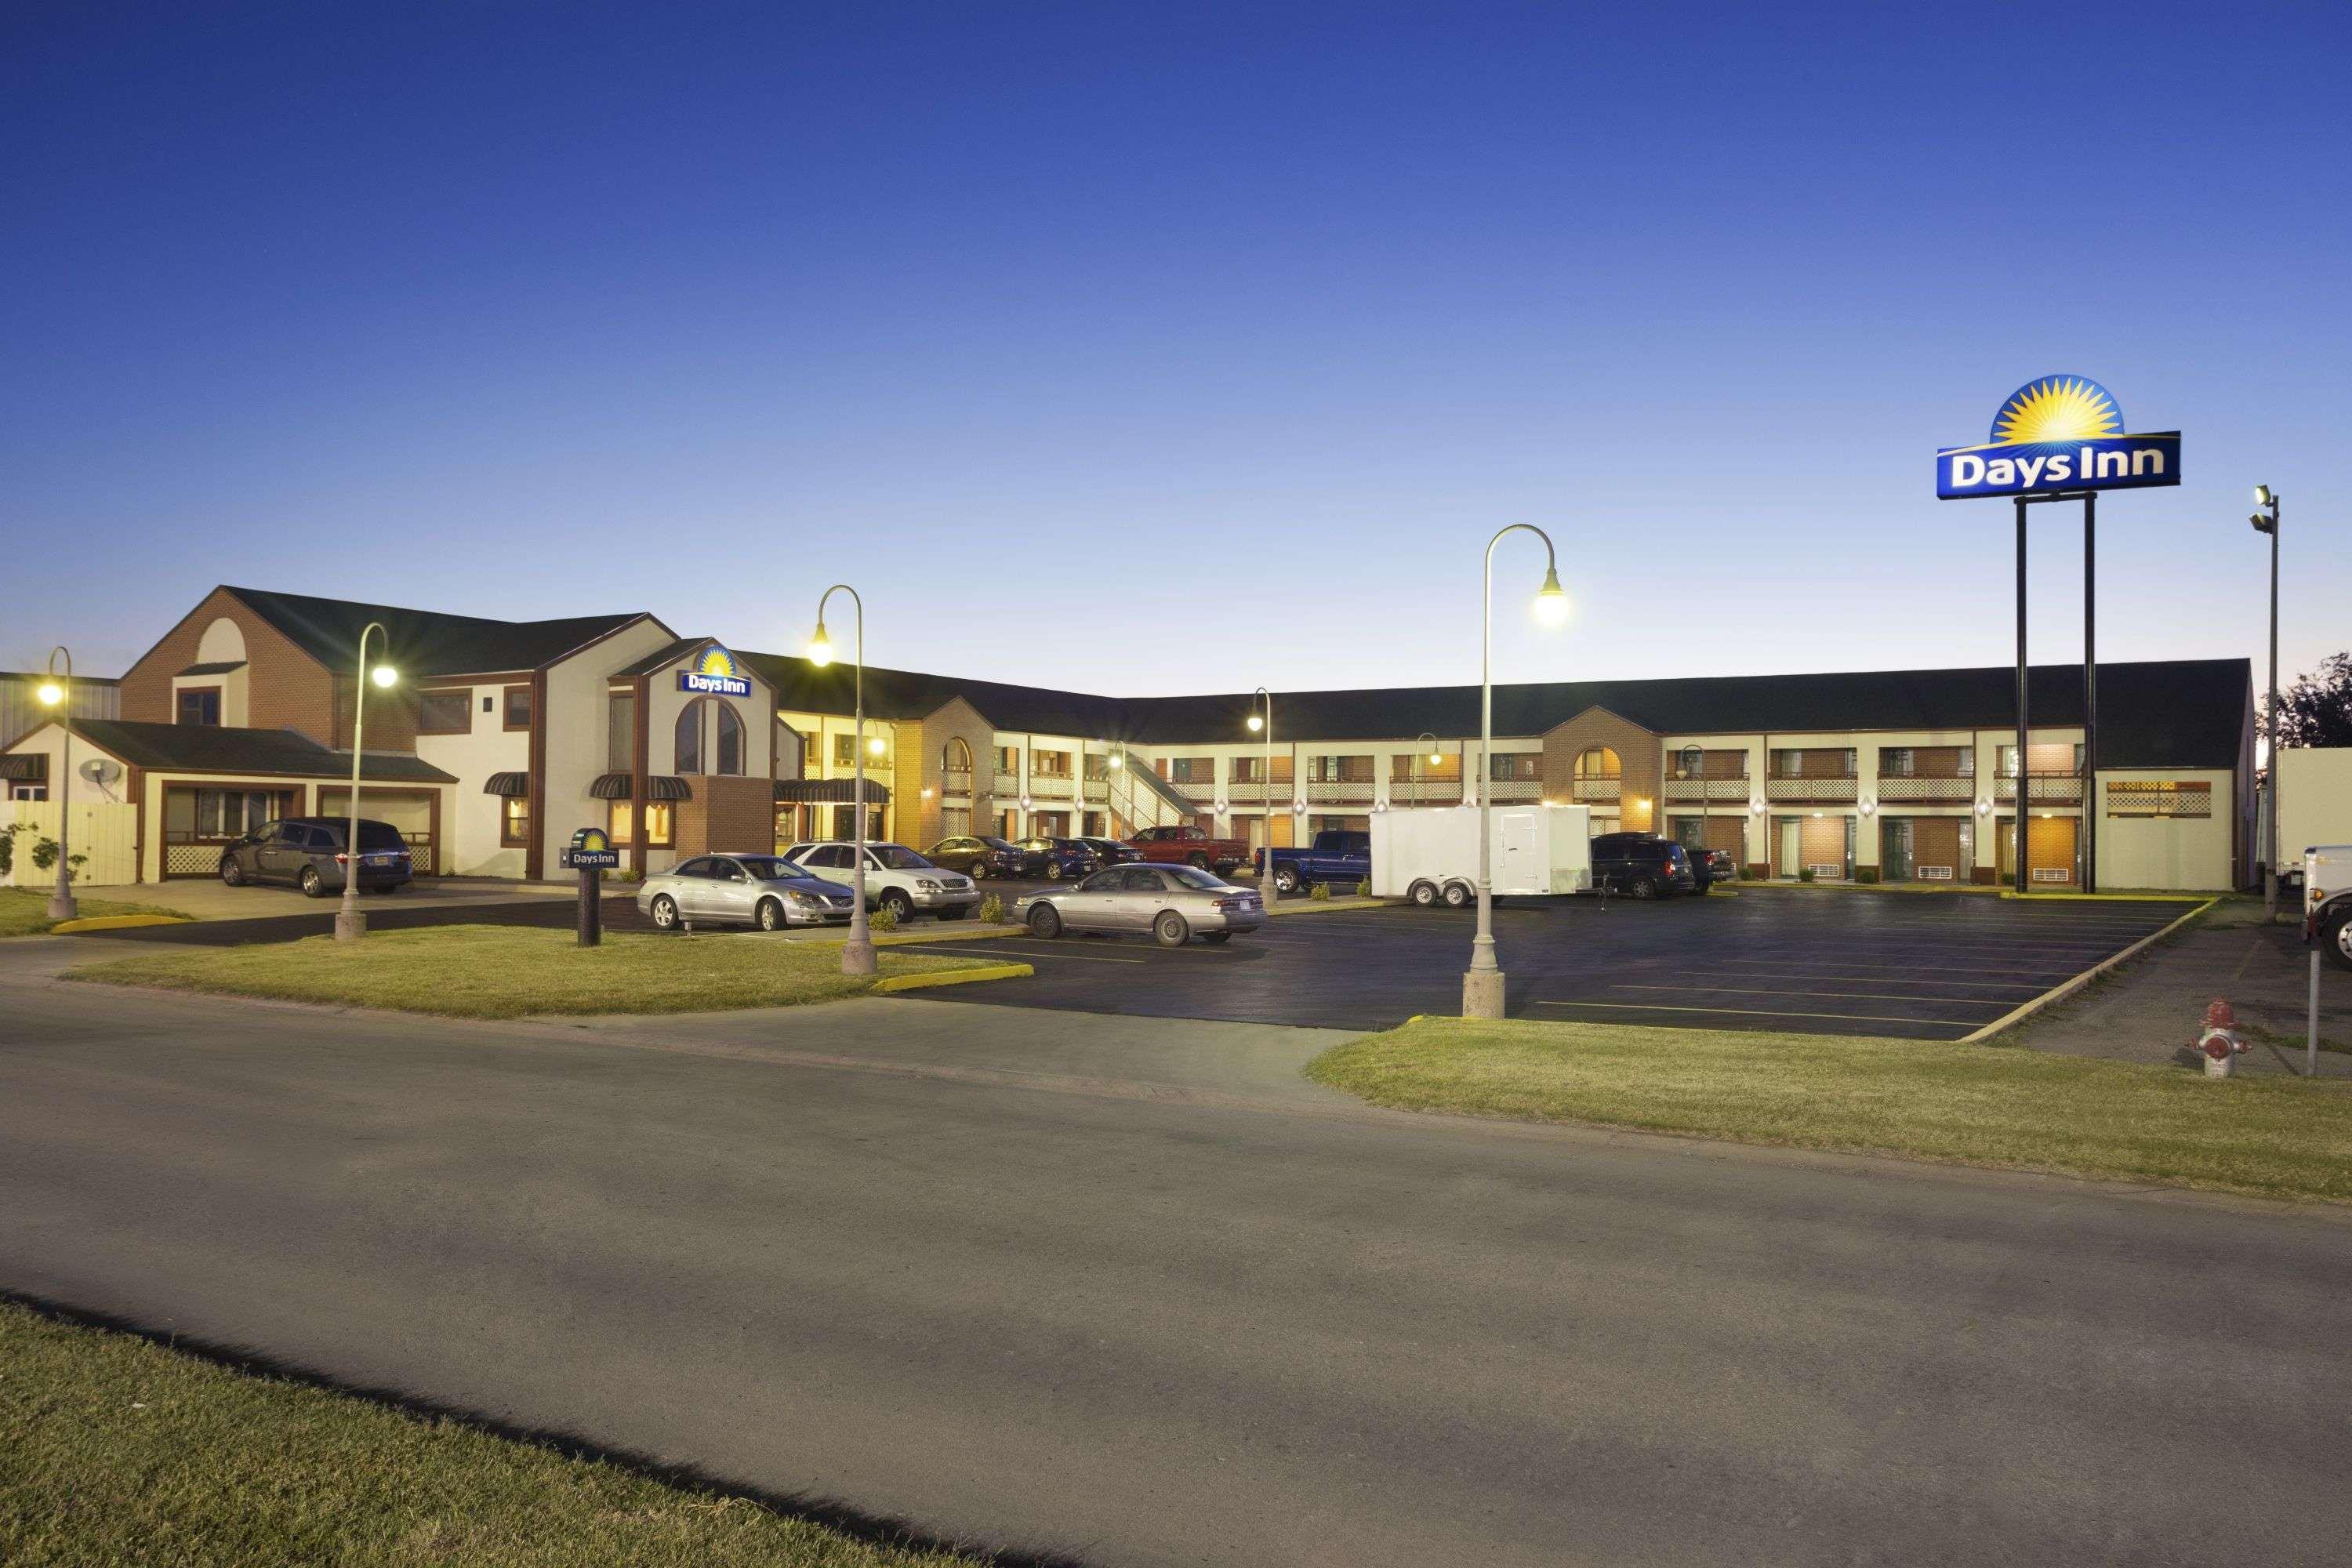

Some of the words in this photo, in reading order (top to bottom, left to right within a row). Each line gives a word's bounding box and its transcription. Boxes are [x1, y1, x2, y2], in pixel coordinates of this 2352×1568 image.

[1951, 455, 2071, 488] Days
[2081, 447, 2165, 479] Inn
[688, 674, 722, 692] Days
[723, 677, 746, 693] Inn
[573, 854, 597, 864] Days
[599, 854, 615, 862] Inn
